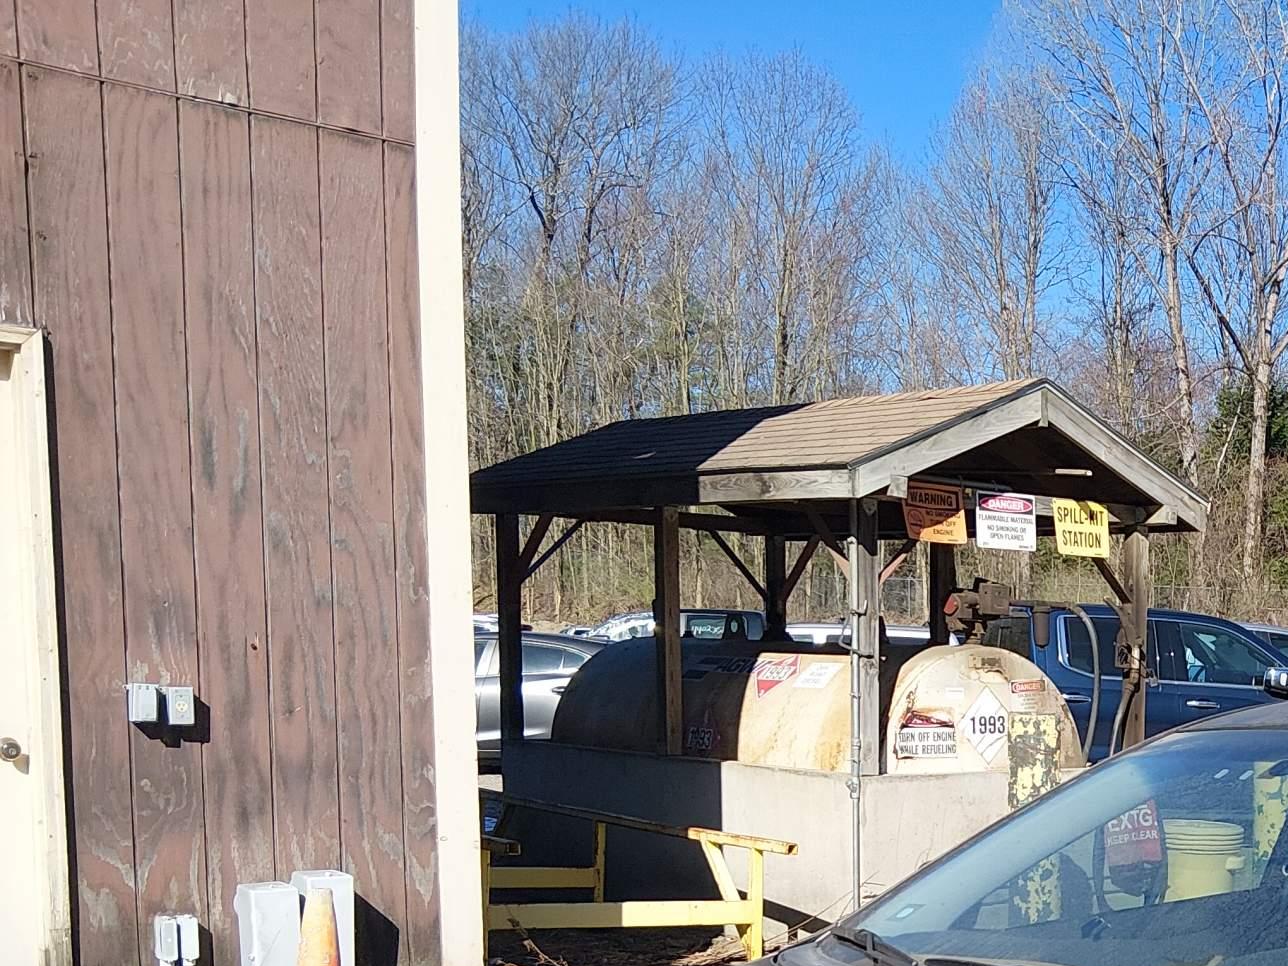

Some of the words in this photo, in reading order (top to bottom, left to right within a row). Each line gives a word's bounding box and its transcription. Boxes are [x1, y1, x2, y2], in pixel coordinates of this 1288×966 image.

[909, 491, 954, 507] WARNING
[995, 525, 1019, 533] SMOKING
[1062, 530, 1102, 549] STATION
[763, 666, 791, 680] 1993
[970, 716, 1006, 735] 1993
[918, 731, 930, 742] OFF
[932, 731, 956, 742] ENGINE
[899, 744, 919, 755] WHILE
[921, 744, 957, 755] REFUELING
[1106, 833, 1129, 847] KEEP
[1131, 830, 1159, 841] CLEAR
